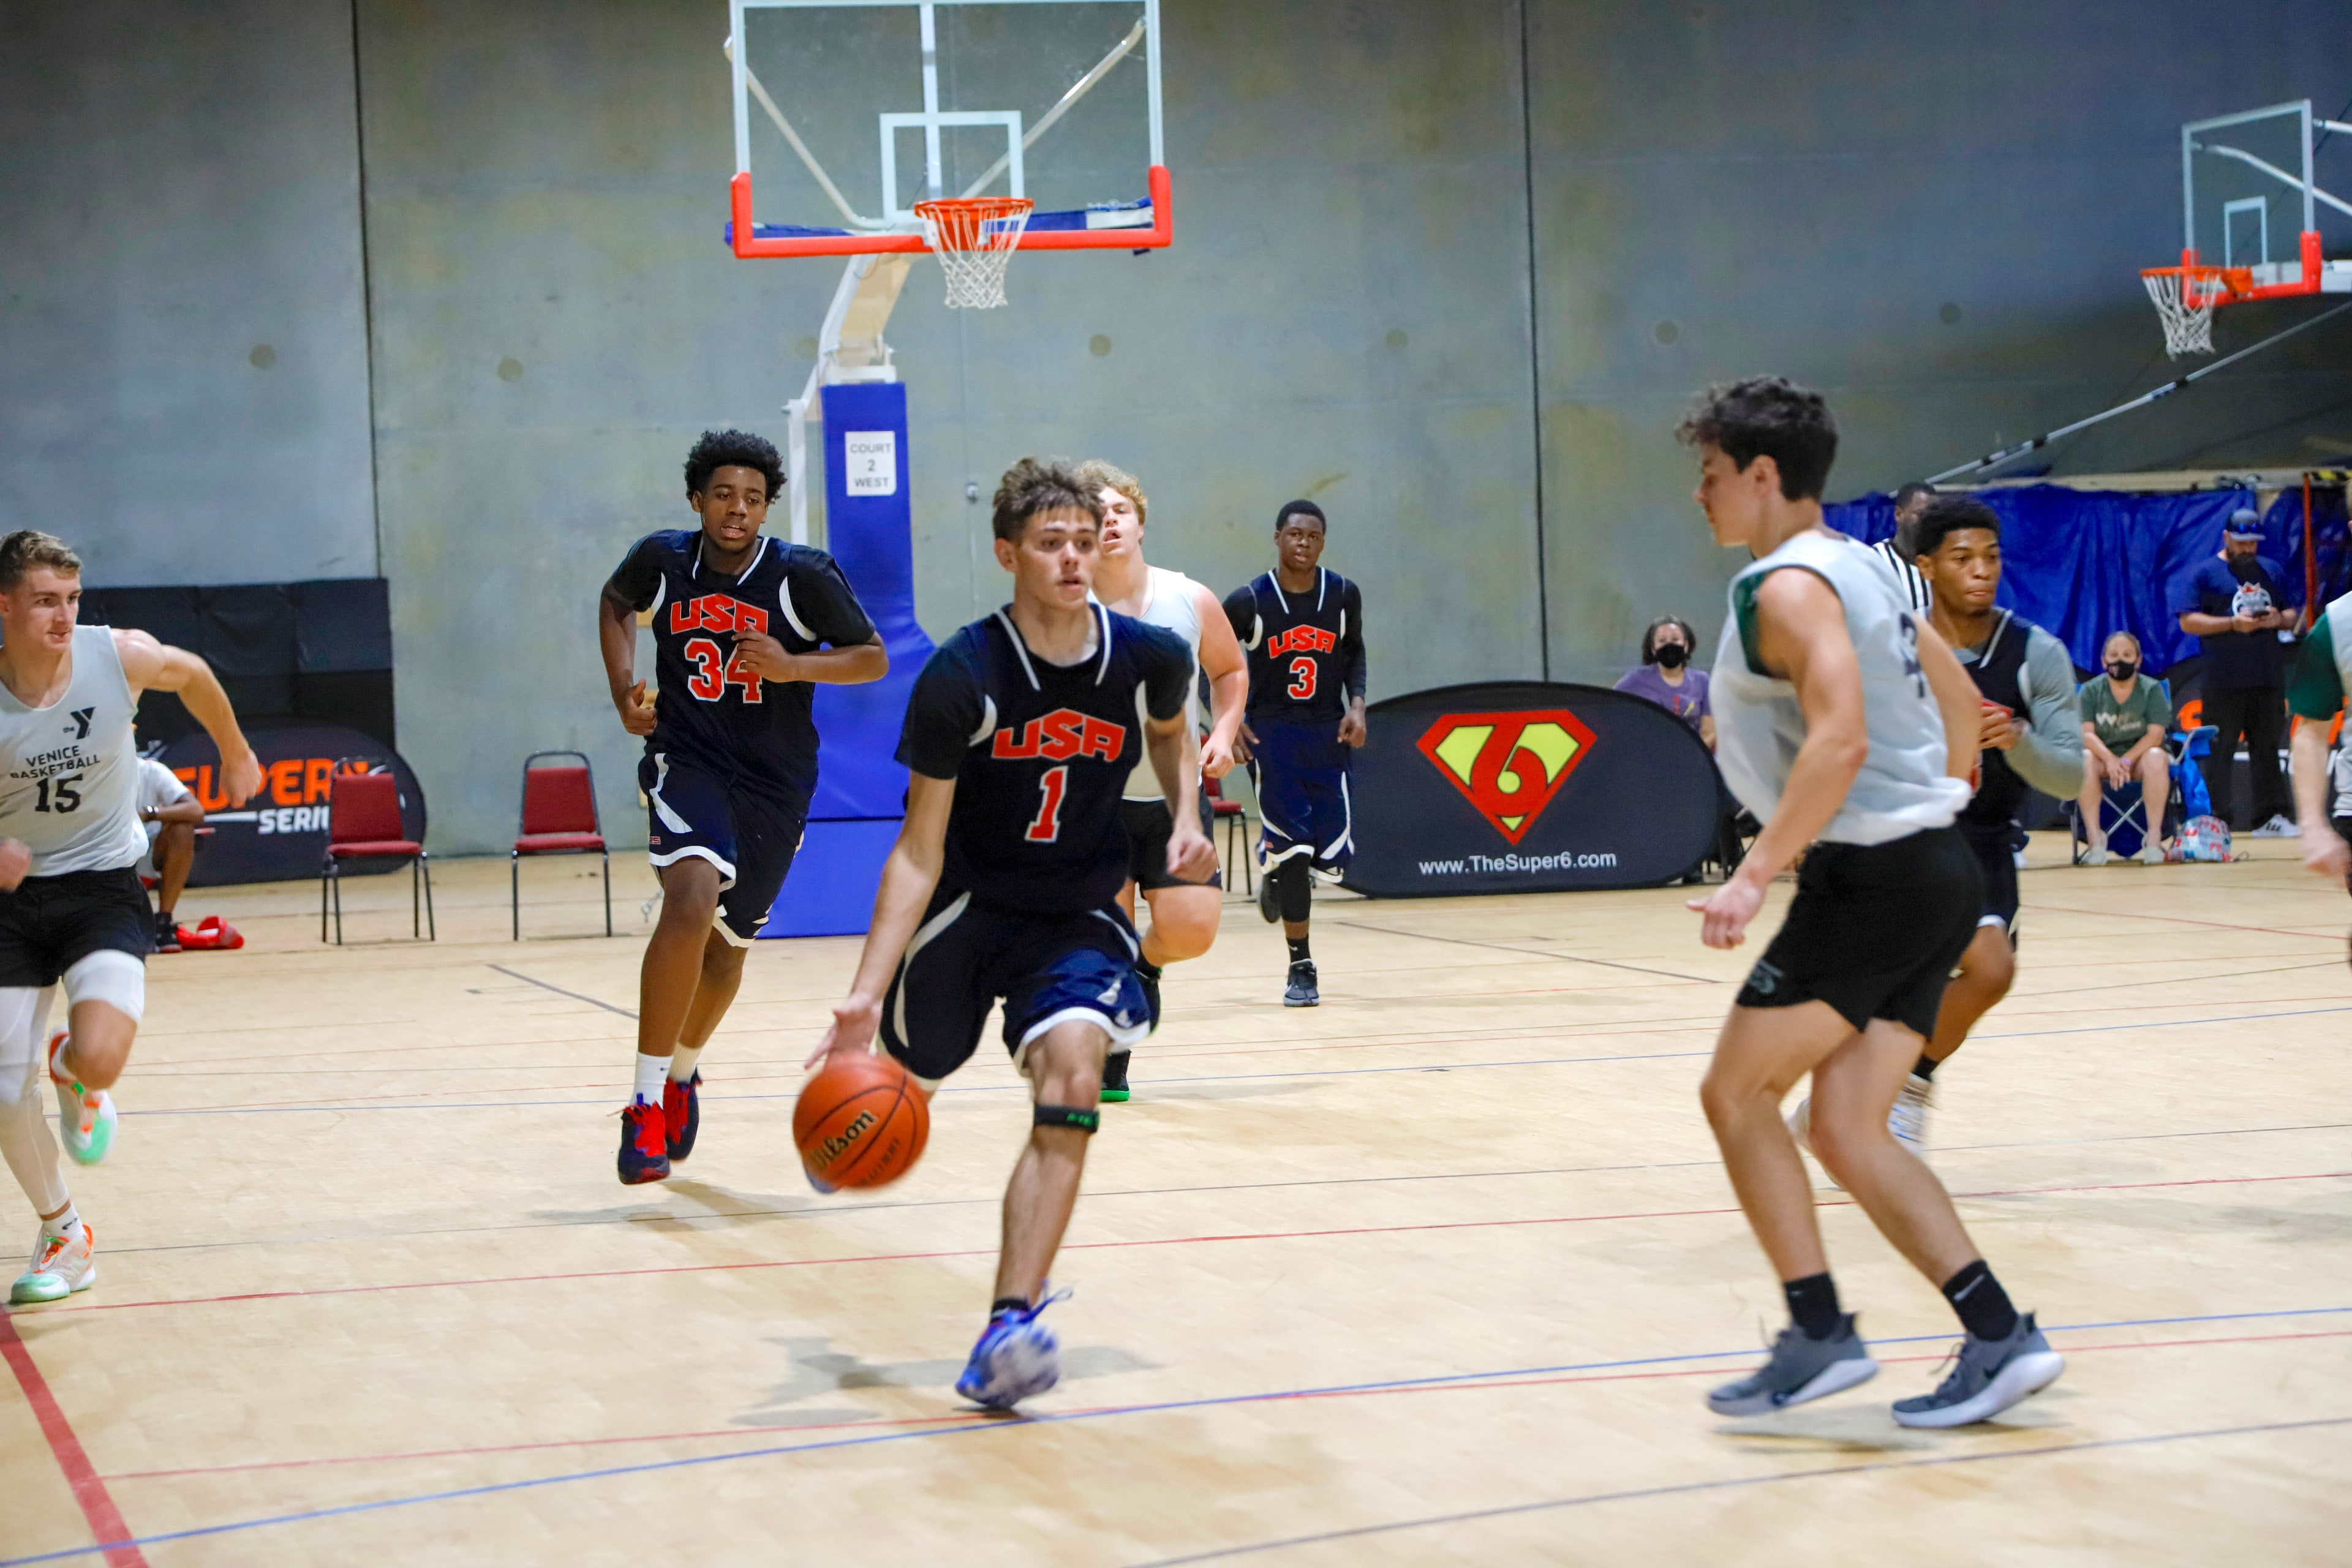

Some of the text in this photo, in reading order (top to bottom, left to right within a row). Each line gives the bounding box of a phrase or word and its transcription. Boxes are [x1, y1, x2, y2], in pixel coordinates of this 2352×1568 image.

[849, 443, 891, 454] COURT
[867, 459, 876, 472] 2
[854, 477, 889, 488] WEST
[670, 592, 768, 635] USA
[1267, 624, 1336, 659] USA
[684, 637, 763, 704] 34
[1287, 657, 1317, 699] 3
[62, 725, 75, 734] the
[991, 707, 1126, 762] USA
[10, 754, 100, 778] BASKETBALL
[26, 745, 80, 767] VENICE
[35, 773, 83, 814] 15
[1024, 765, 1069, 843] 1
[1418, 851, 1617, 875] www.TheSuper6.com
